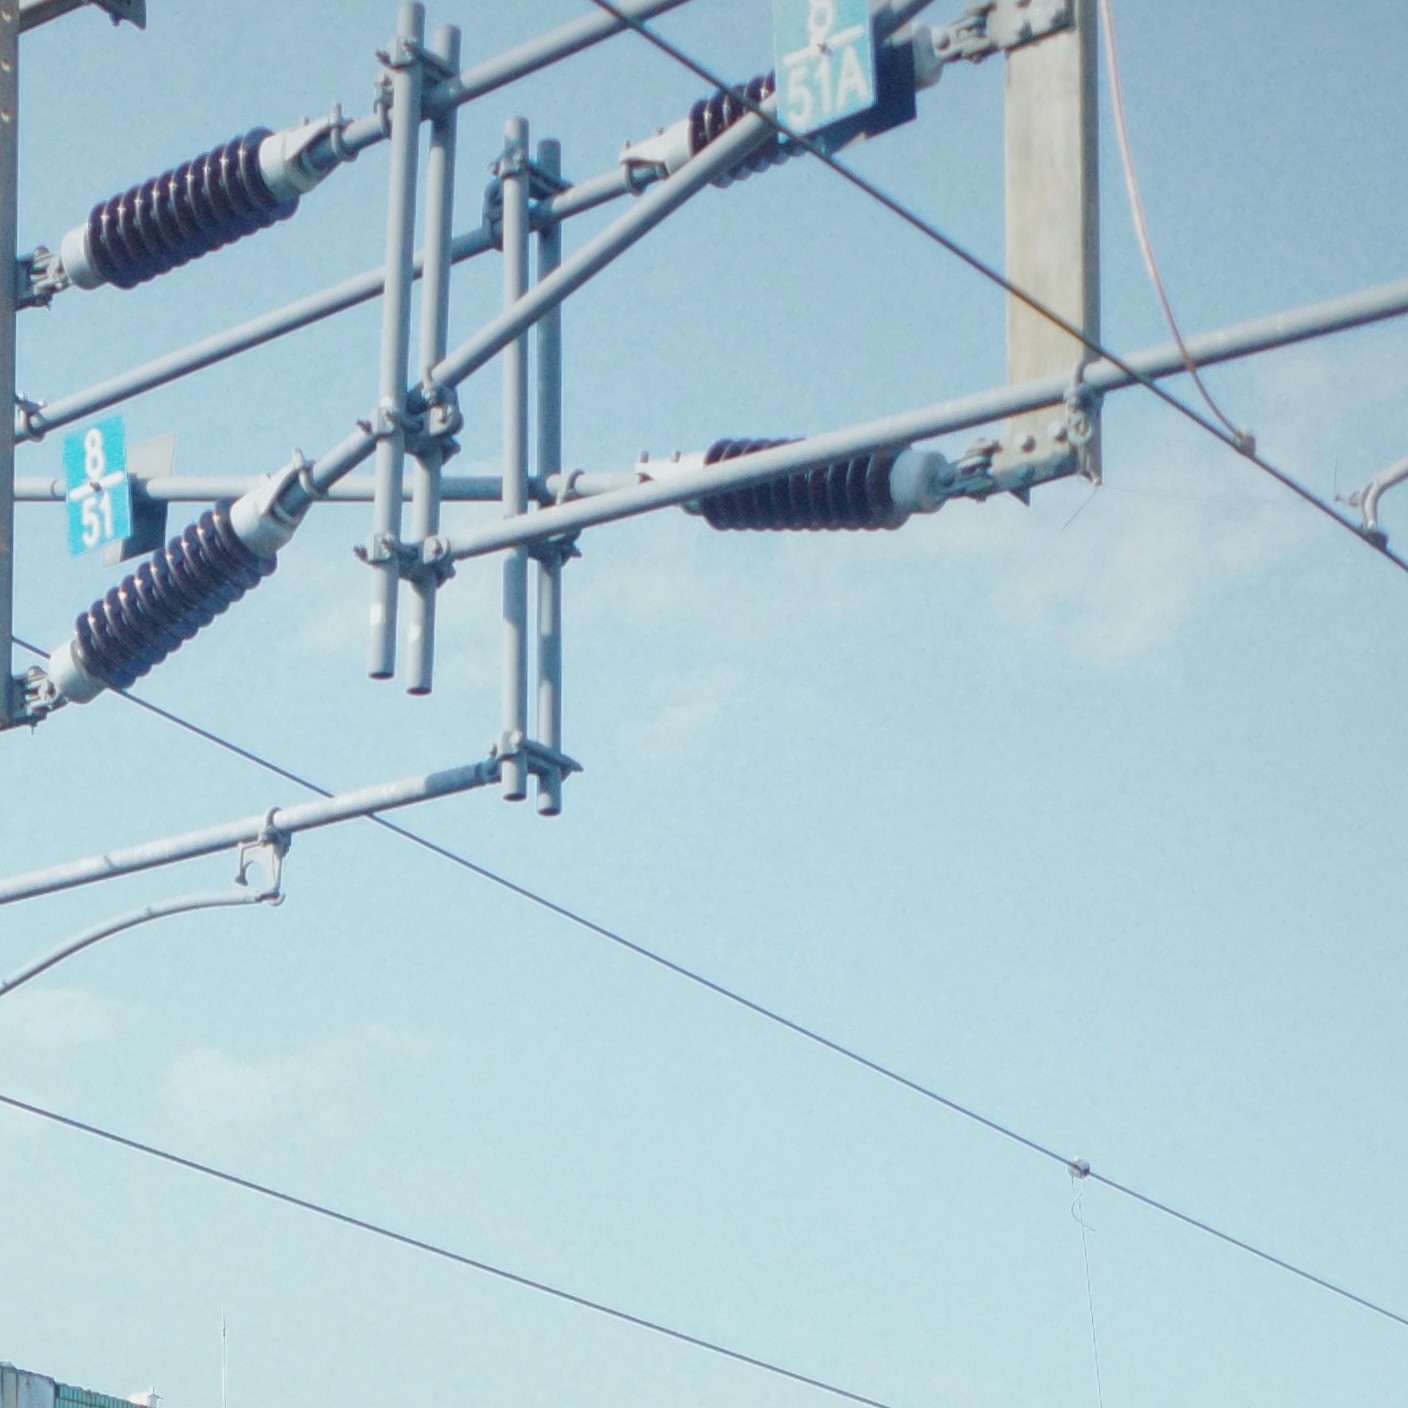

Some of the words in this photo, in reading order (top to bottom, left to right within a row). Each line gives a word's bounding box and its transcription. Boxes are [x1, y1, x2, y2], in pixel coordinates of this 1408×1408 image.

[788, 45, 869, 131] 51A
[84, 428, 105, 478] 8
[82, 493, 114, 548] 51
